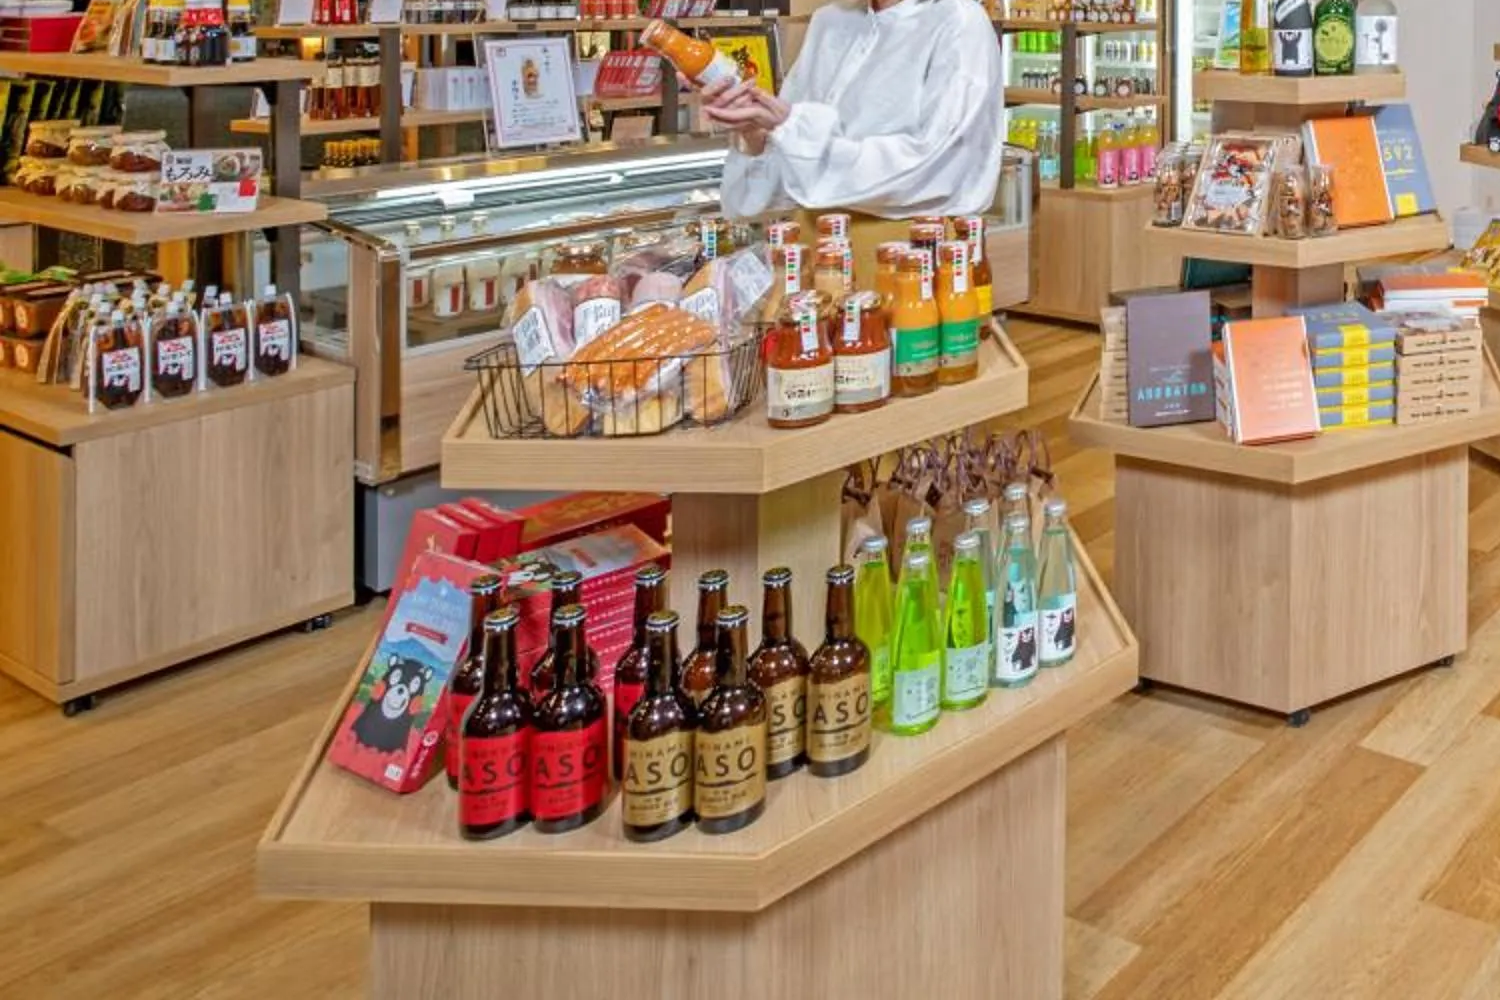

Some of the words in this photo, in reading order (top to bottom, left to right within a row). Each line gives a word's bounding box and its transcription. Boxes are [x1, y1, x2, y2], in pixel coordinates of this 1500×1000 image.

[166, 165, 211, 182] もろみ
[771, 695, 805, 727] SO
[813, 692, 869, 724] ASO
[463, 751, 526, 787] ASO
[536, 744, 601, 780] ASO
[626, 752, 690, 785] ASO
[697, 746, 756, 778] ASO
